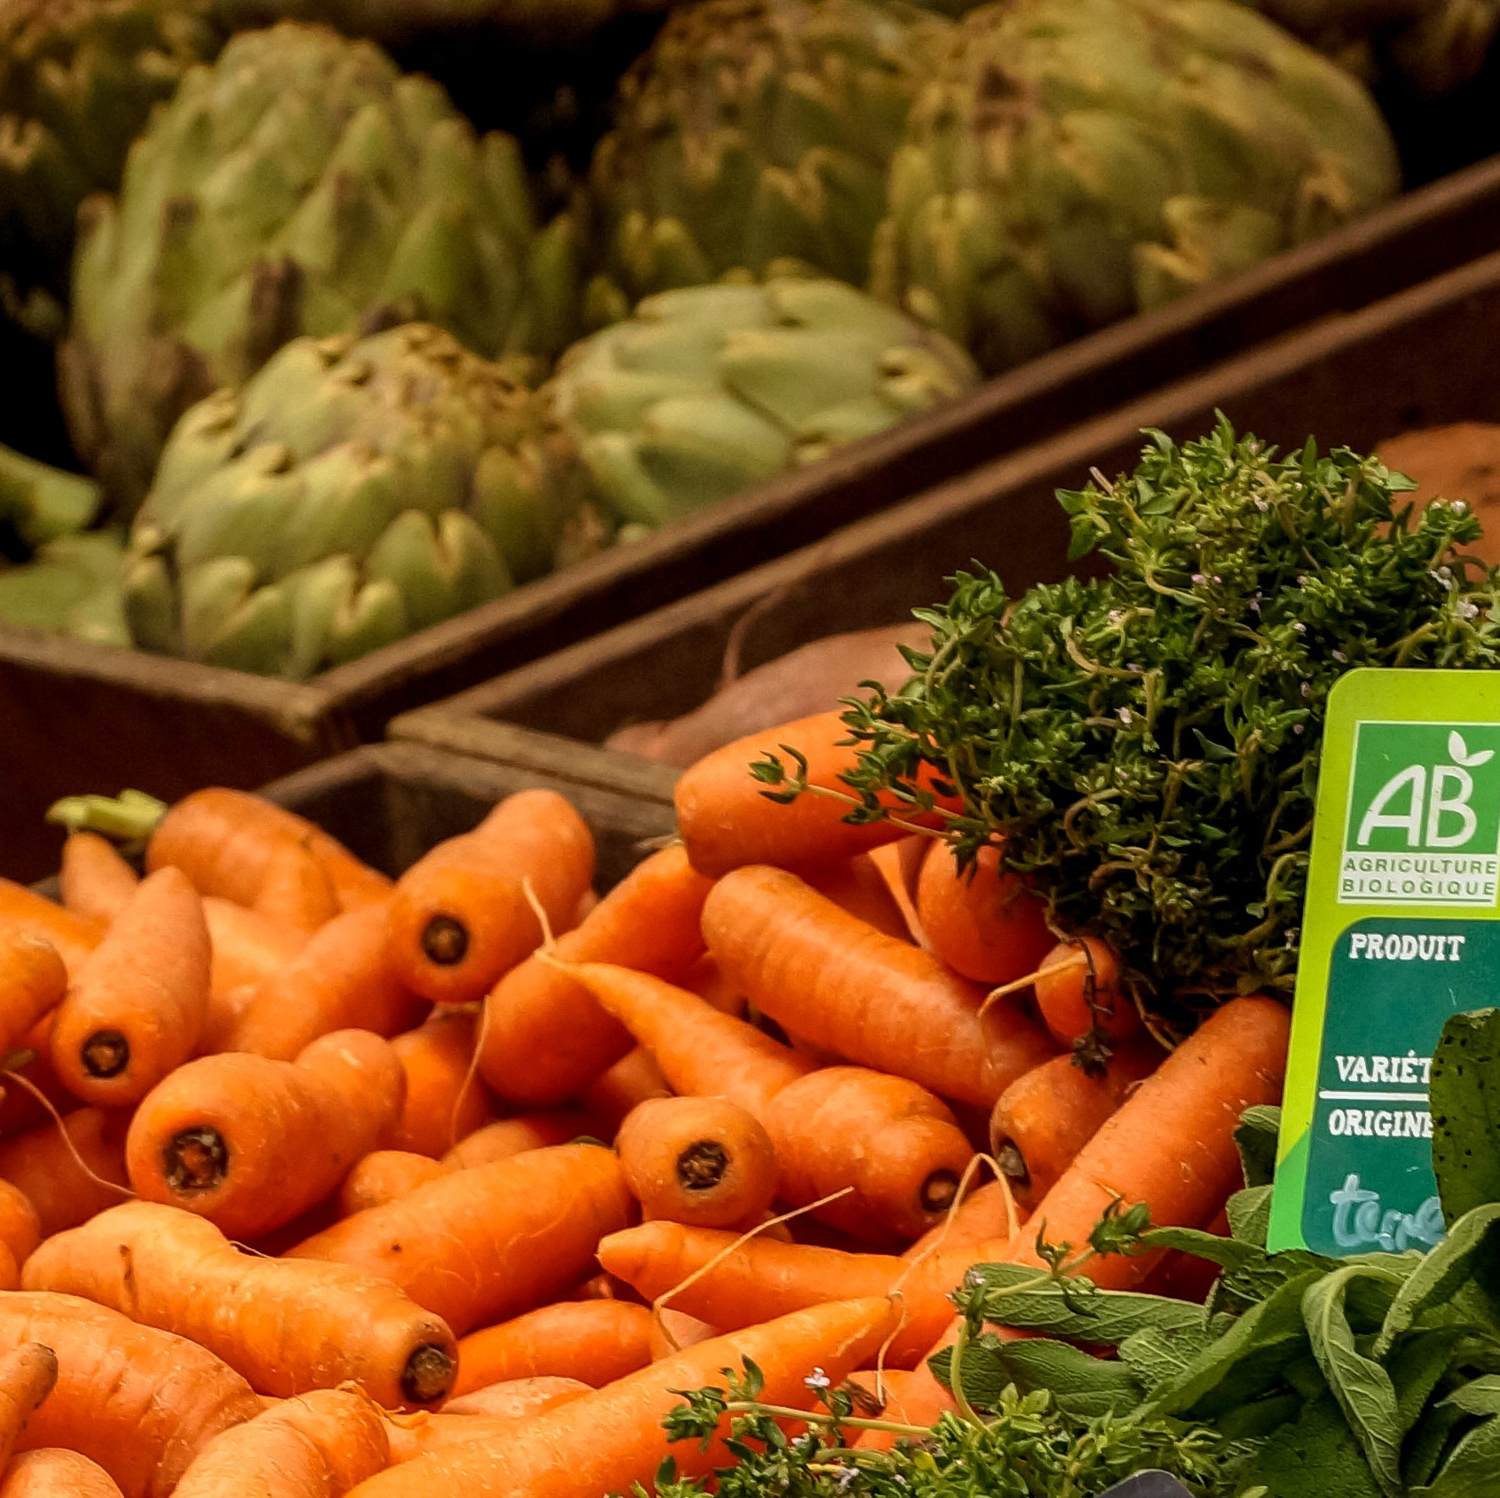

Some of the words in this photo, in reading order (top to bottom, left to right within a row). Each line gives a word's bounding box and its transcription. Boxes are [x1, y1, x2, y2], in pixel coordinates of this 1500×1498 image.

[1356, 764, 1478, 848] AB
[1343, 857, 1498, 875] AGRICULTURE
[1342, 878, 1496, 897] BIOLOGIQUE
[1349, 933, 1465, 961] PRODUIT
[1335, 1049, 1433, 1084] VARIÉT
